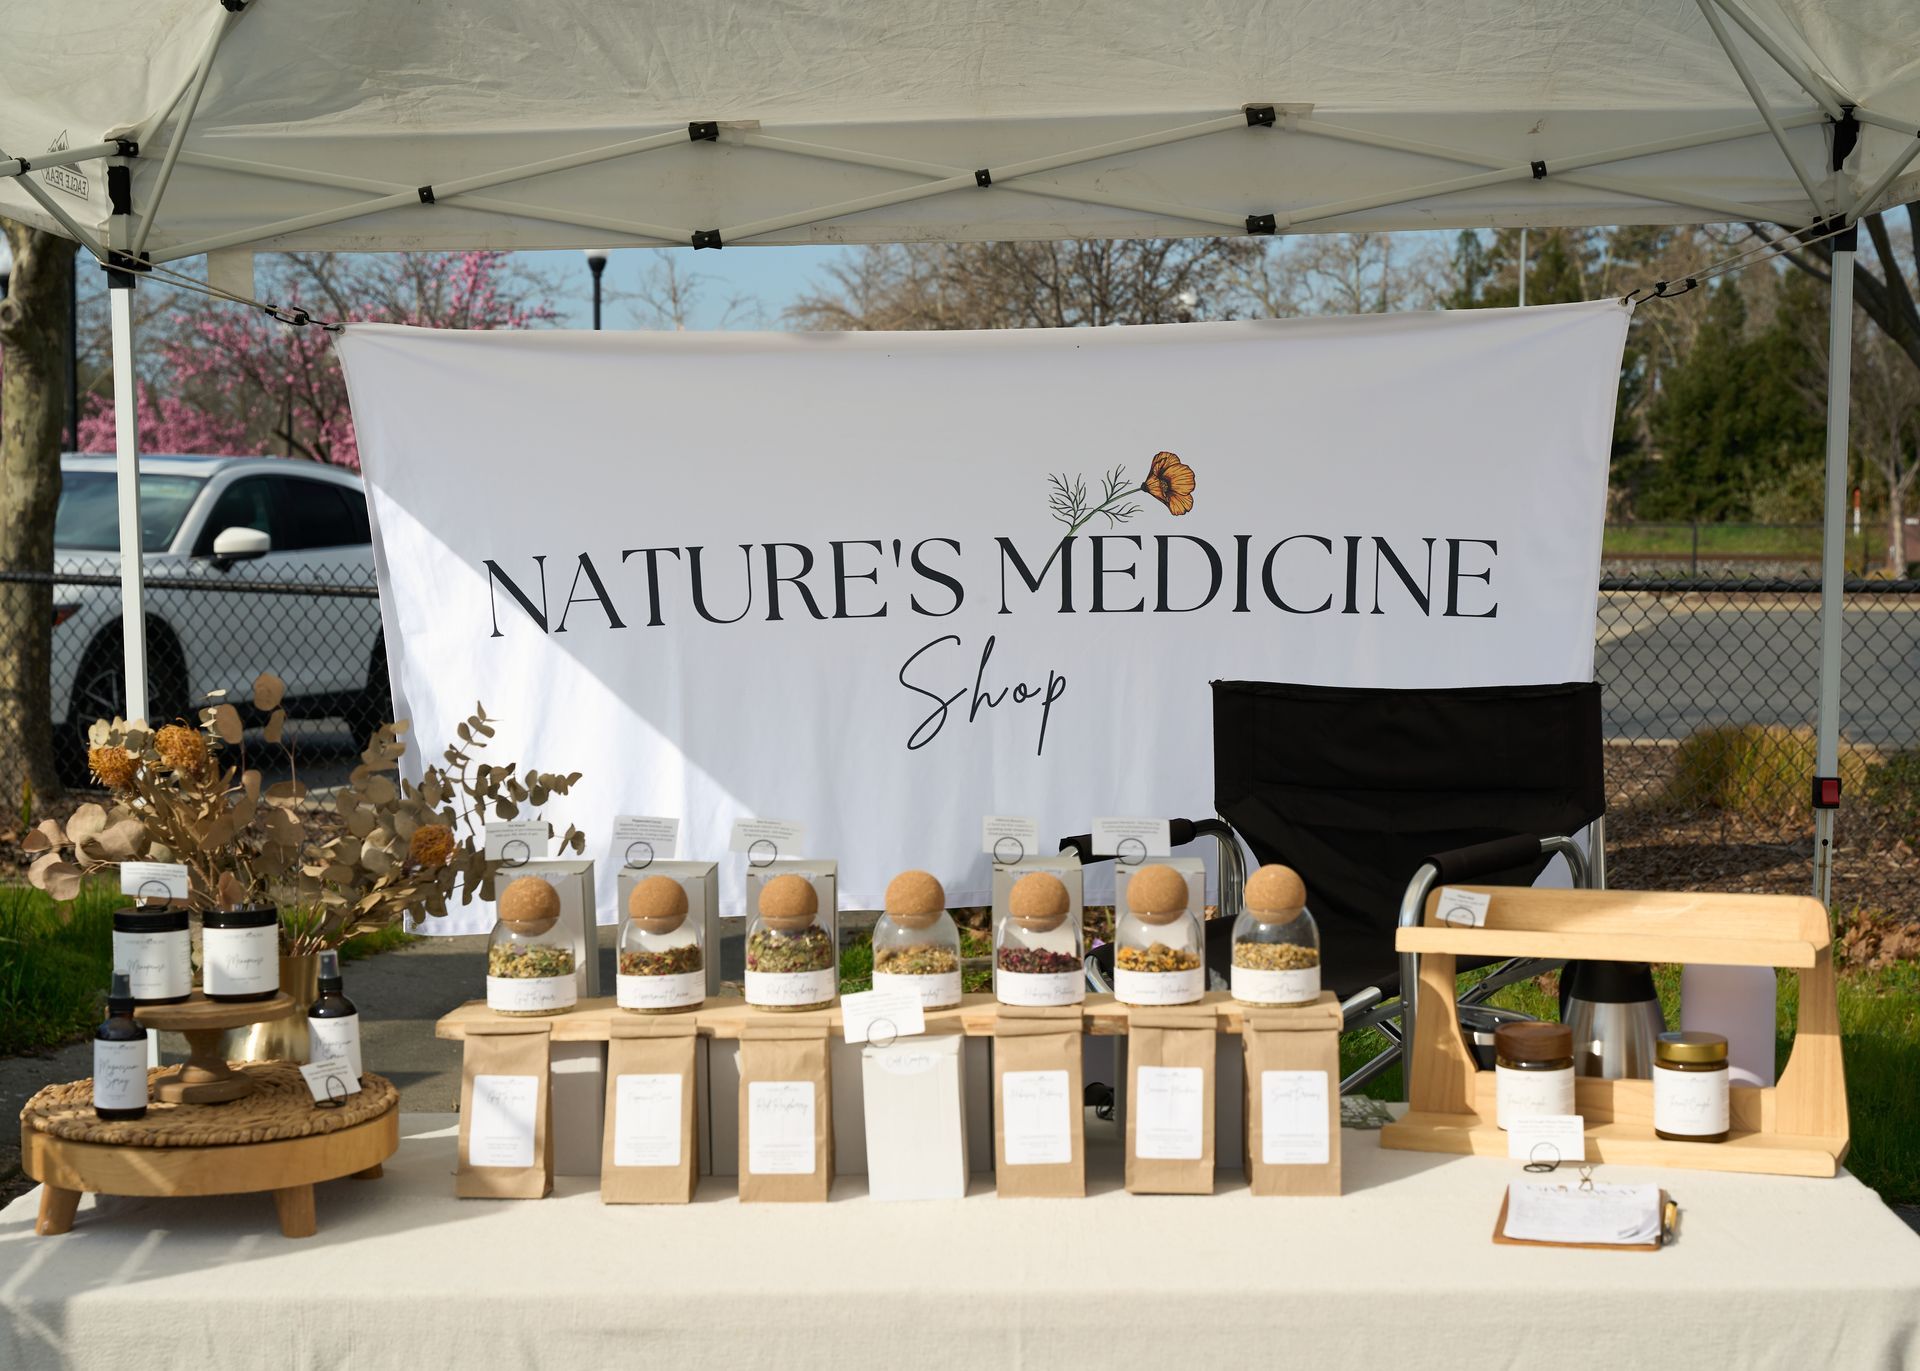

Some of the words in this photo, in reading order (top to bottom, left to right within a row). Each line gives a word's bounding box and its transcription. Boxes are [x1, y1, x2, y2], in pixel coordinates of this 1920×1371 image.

[482, 538, 965, 637] NATURE'S
[994, 532, 1498, 618] MEDICINE
[899, 635, 1067, 756] Shop
